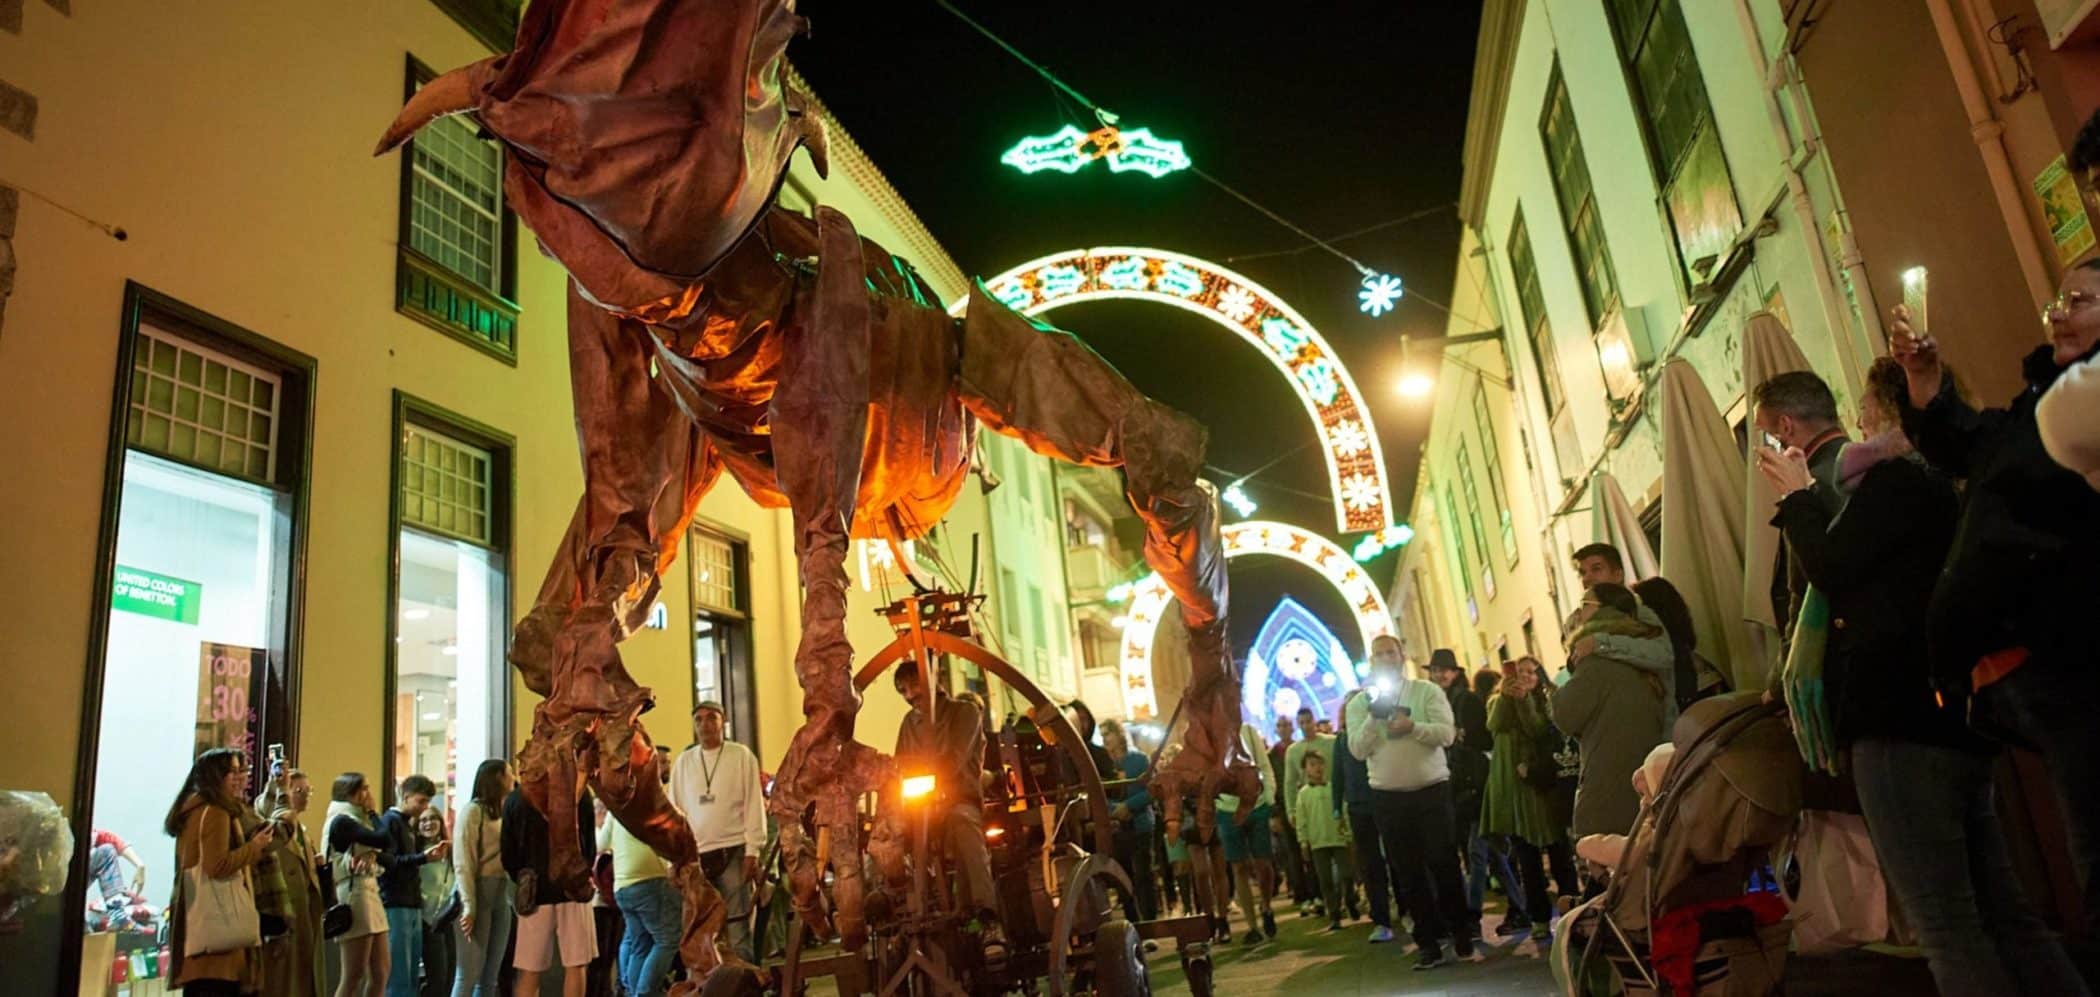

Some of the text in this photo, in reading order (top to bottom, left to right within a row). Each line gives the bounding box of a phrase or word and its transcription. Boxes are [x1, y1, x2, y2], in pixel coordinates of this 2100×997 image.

[116, 584, 129, 595] OF
[117, 573, 184, 596] UNITED COLORS
[206, 656, 251, 677] TODO
